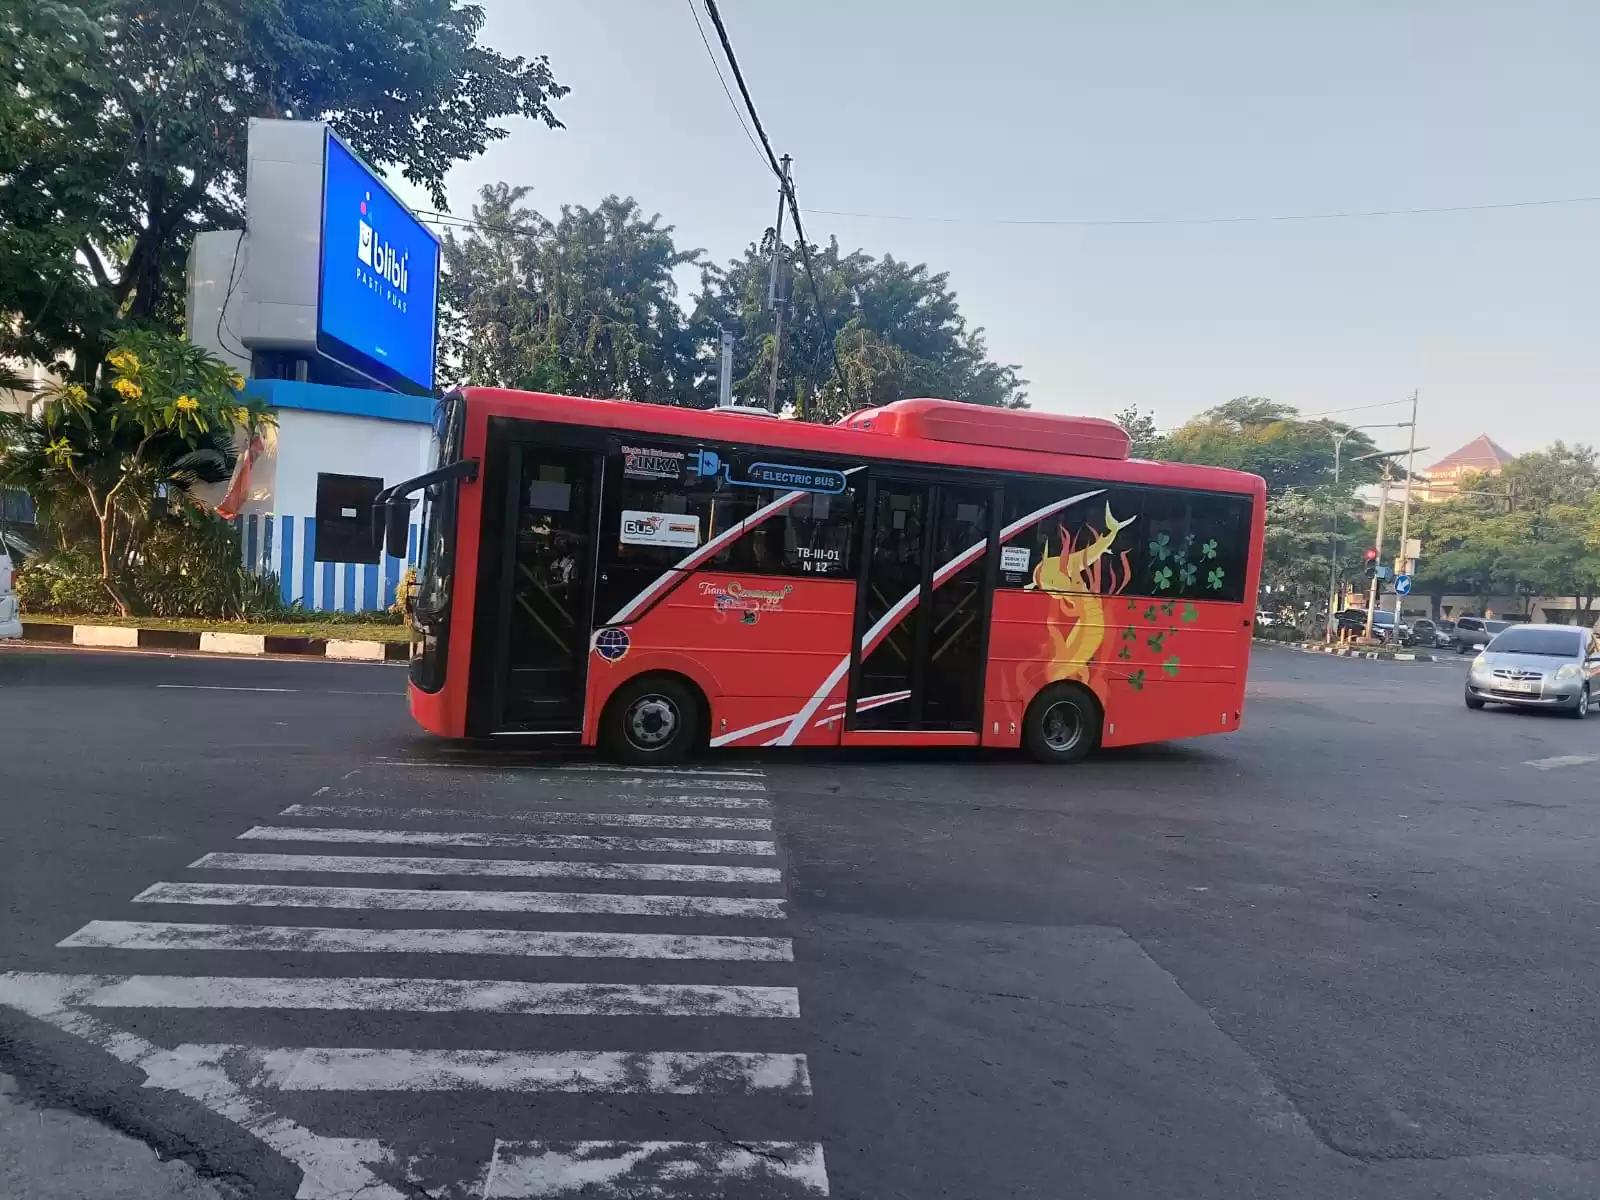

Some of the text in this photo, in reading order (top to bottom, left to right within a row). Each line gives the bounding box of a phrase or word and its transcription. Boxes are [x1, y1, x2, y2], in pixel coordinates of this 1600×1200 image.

[373, 231, 409, 294] blibli
[356, 267, 407, 314] PASTI PUAS
[637, 455, 680, 473] INKA
[762, 470, 835, 487] ELECTRIC BUS
[625, 520, 656, 536] Bus
[796, 547, 840, 561] TB-III-01
[803, 560, 828, 573] N 12
[699, 581, 727, 596] Trans
